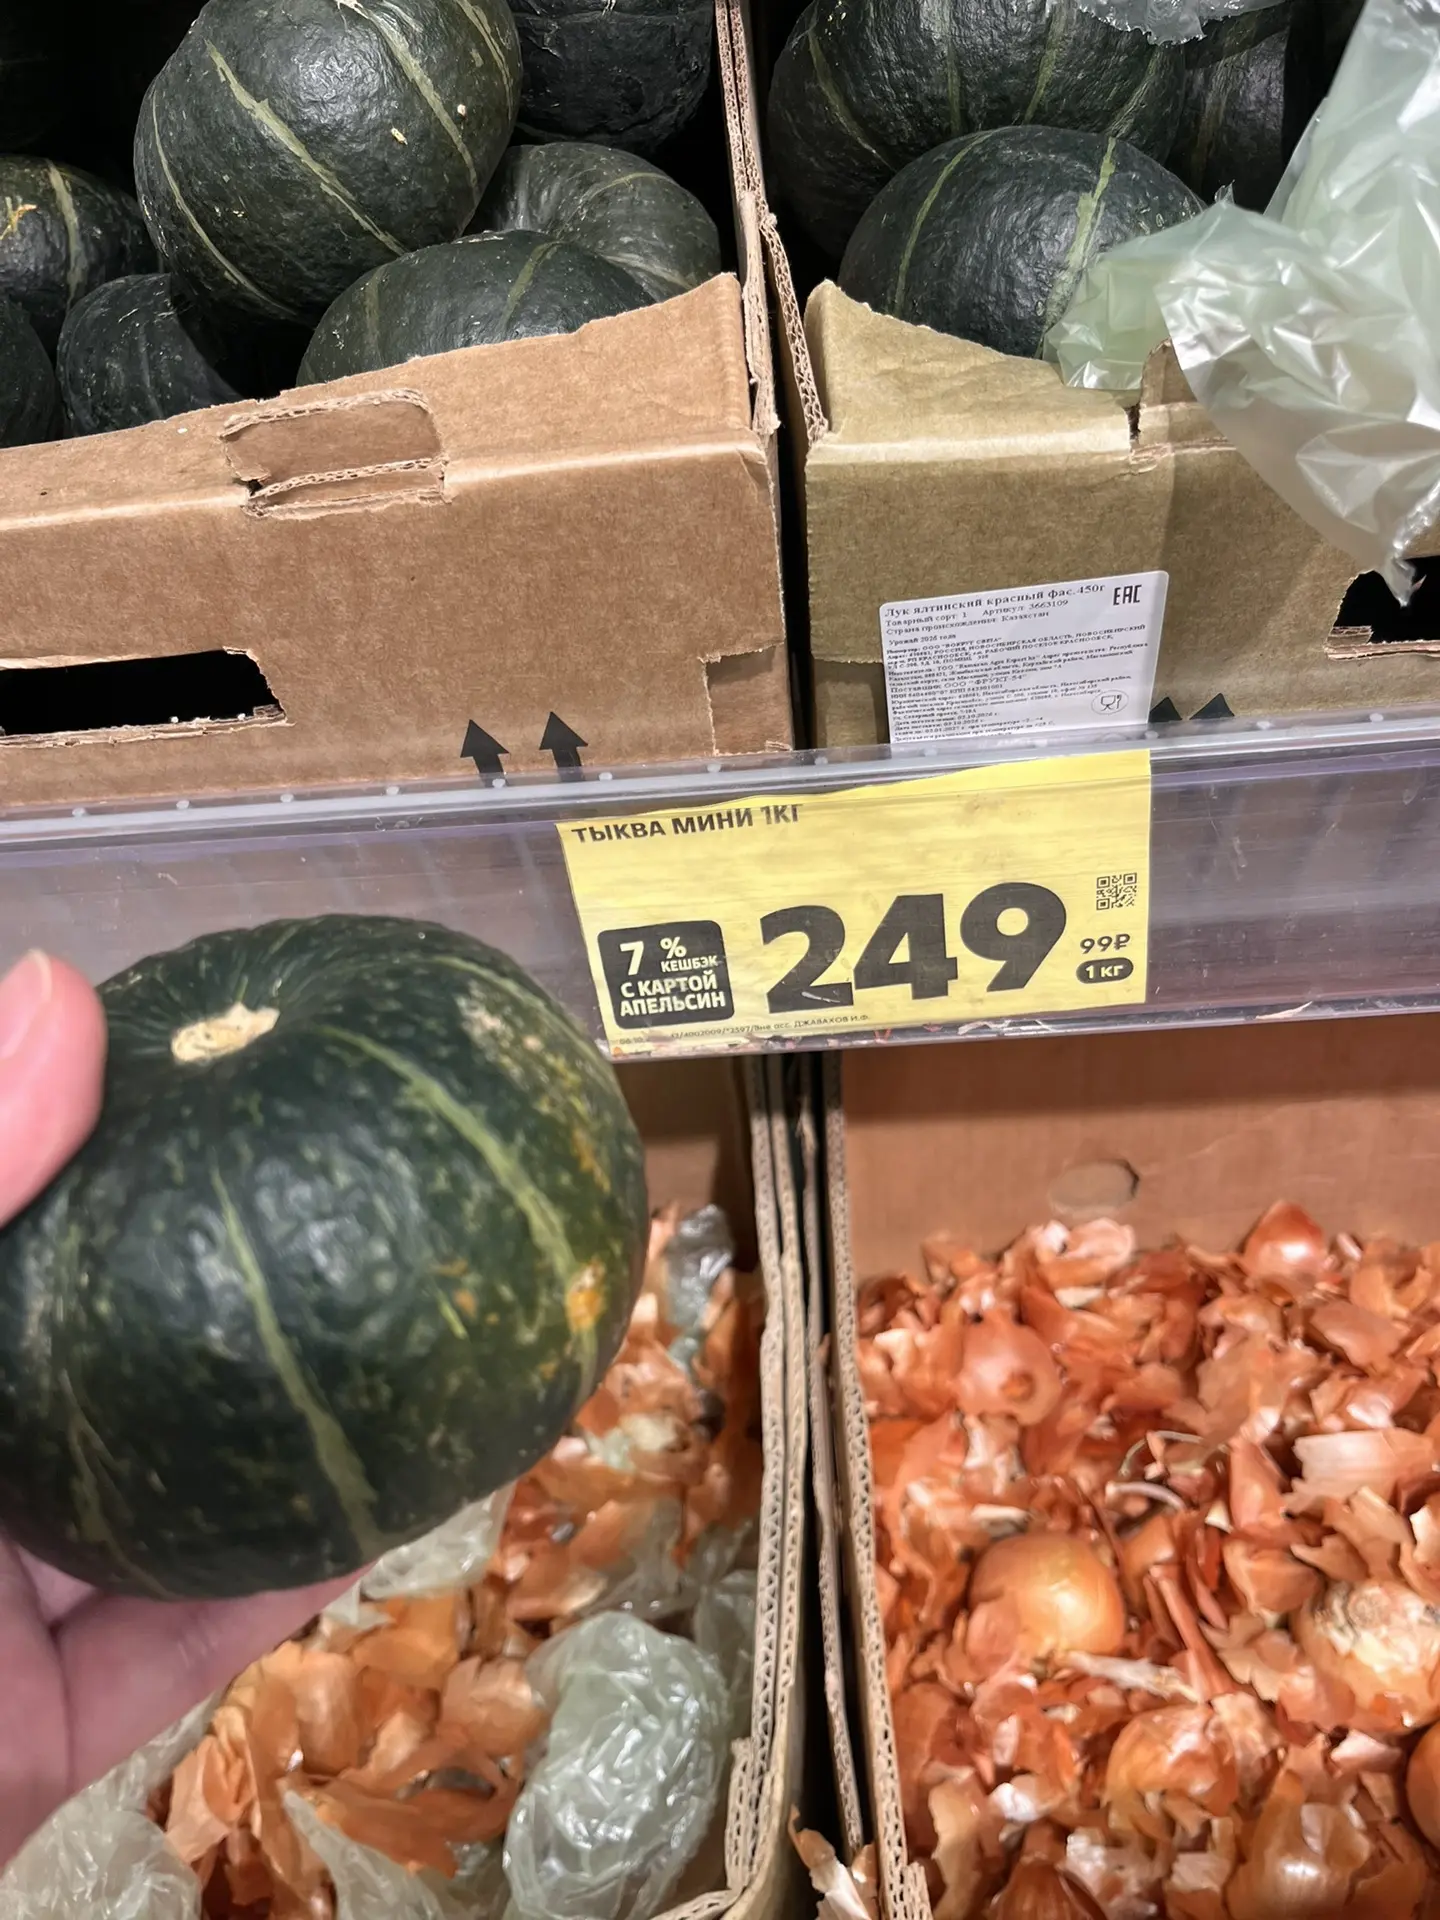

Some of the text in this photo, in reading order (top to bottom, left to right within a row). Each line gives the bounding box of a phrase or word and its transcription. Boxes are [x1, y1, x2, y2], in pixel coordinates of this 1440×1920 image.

[885, 608, 909, 619] Лук
[914, 600, 981, 613] ялтинский
[987, 593, 1043, 607] красный
[885, 616, 933, 627] Товарный
[886, 627, 919, 636] Страна
[571, 803, 803, 843] ТЫКВА МИНИ 1КГ
[620, 936, 687, 976] 7 %
[760, 882, 1067, 1014] 249
[661, 955, 718, 972] КЕШБЭК
[1085, 965, 1094, 979] 1
[620, 969, 718, 998] С КАРТОЙ
[620, 991, 726, 1017] АПЕЛЬСИН
